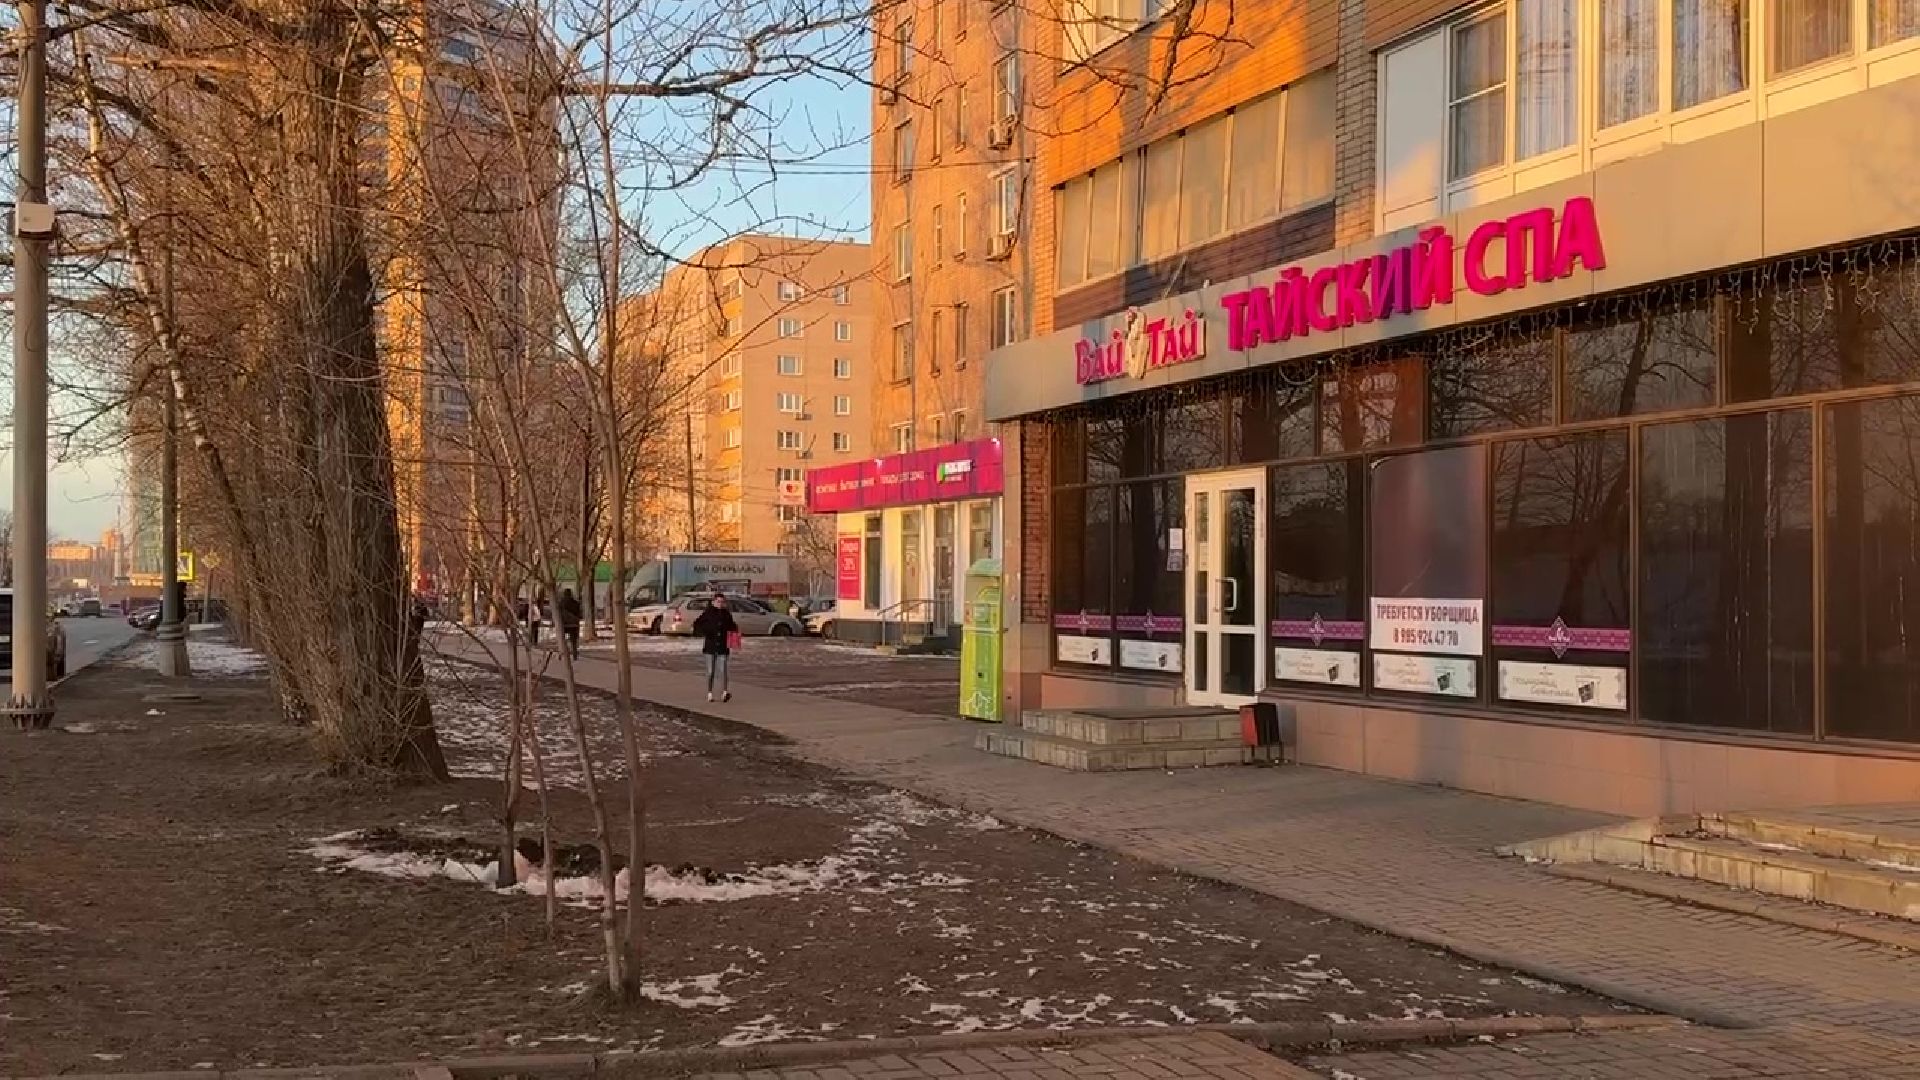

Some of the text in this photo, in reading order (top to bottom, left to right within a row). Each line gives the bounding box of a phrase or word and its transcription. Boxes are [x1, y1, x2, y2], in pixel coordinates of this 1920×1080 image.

[1222, 197, 1607, 351] ТАЙСКИЙ СПА
[1376, 603, 1480, 624] ТРЕБУЕТСЯ УБОРЩИЦА
[1393, 627, 1399, 643] 8
[1434, 630, 1445, 646] 47
